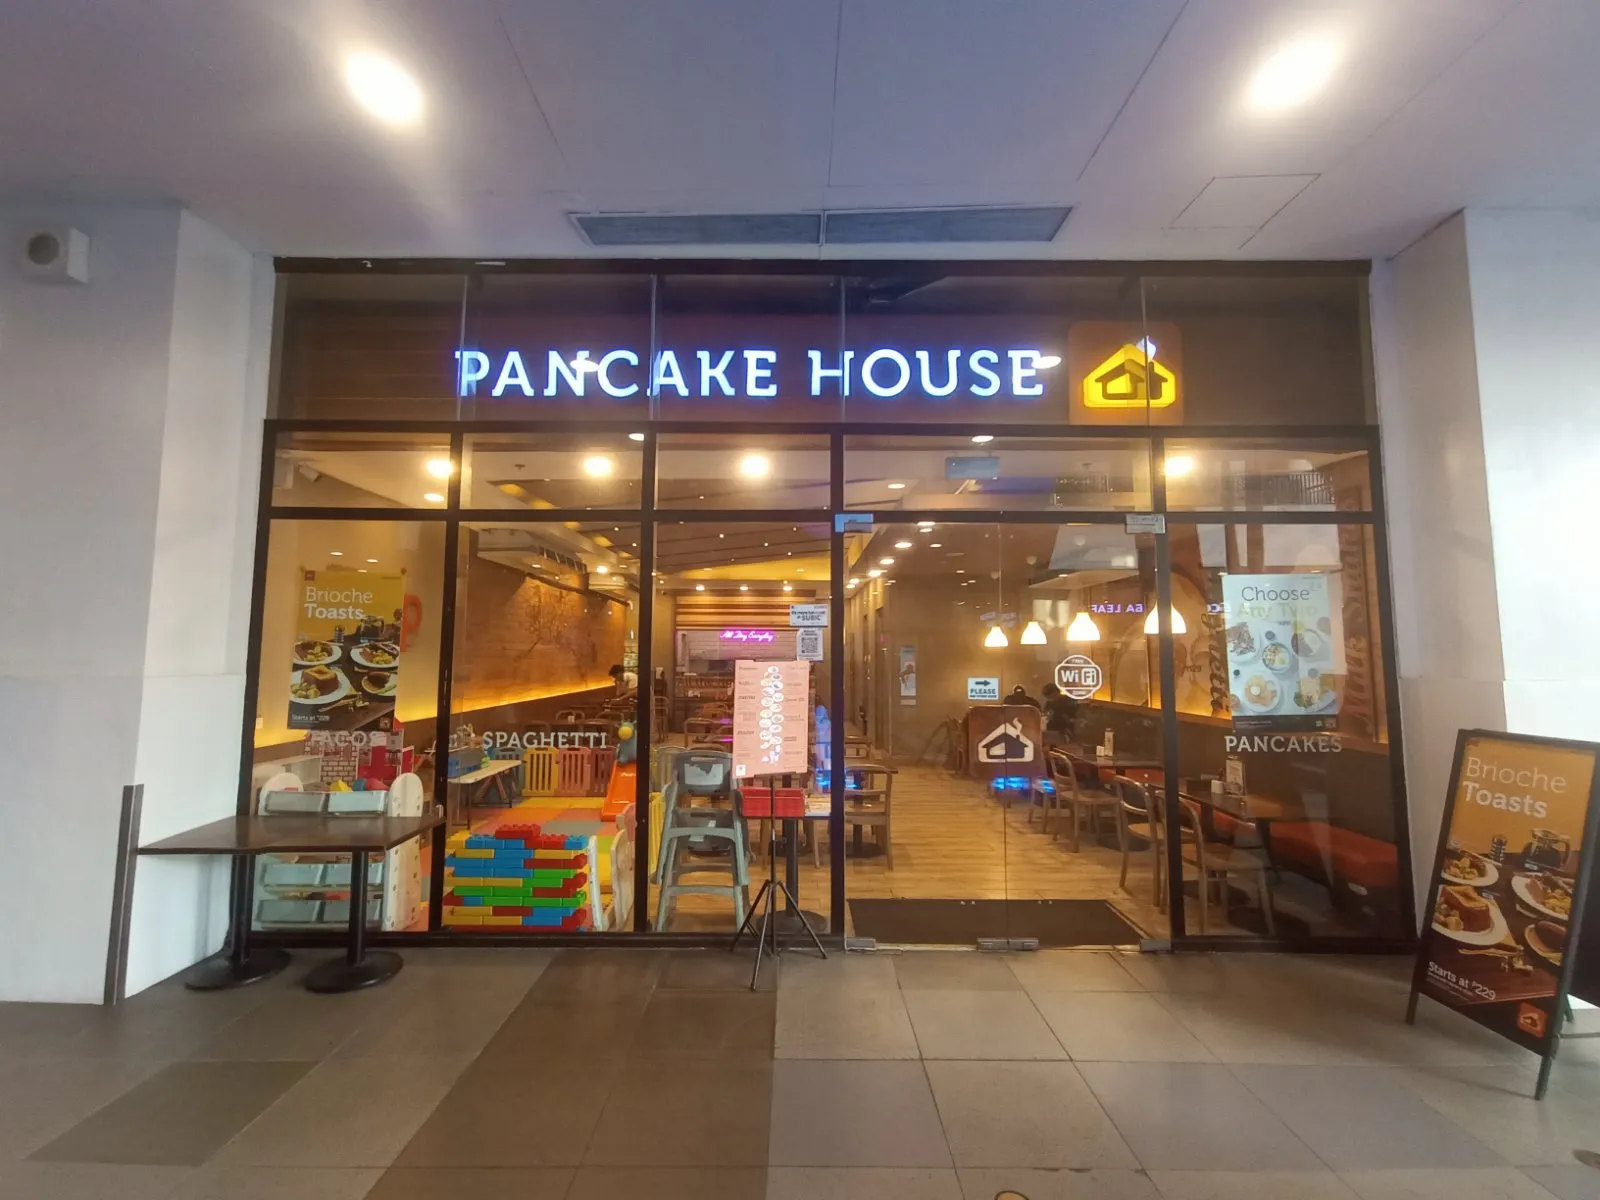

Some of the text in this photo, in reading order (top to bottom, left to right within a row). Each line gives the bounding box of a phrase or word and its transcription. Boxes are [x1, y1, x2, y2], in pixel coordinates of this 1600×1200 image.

[455, 349, 1044, 398] PANCAKE HOUSE
[306, 586, 373, 603] Brioche
[1241, 586, 1310, 602] Choose
[304, 603, 367, 620] Toasts
[482, 731, 608, 749] SPAGHETTI
[1224, 735, 1342, 753] PANCAKES
[1466, 756, 1568, 794] Brioche
[1463, 780, 1548, 819] Toasts
[1428, 961, 1457, 983] Starts
[1458, 977, 1470, 989] at
